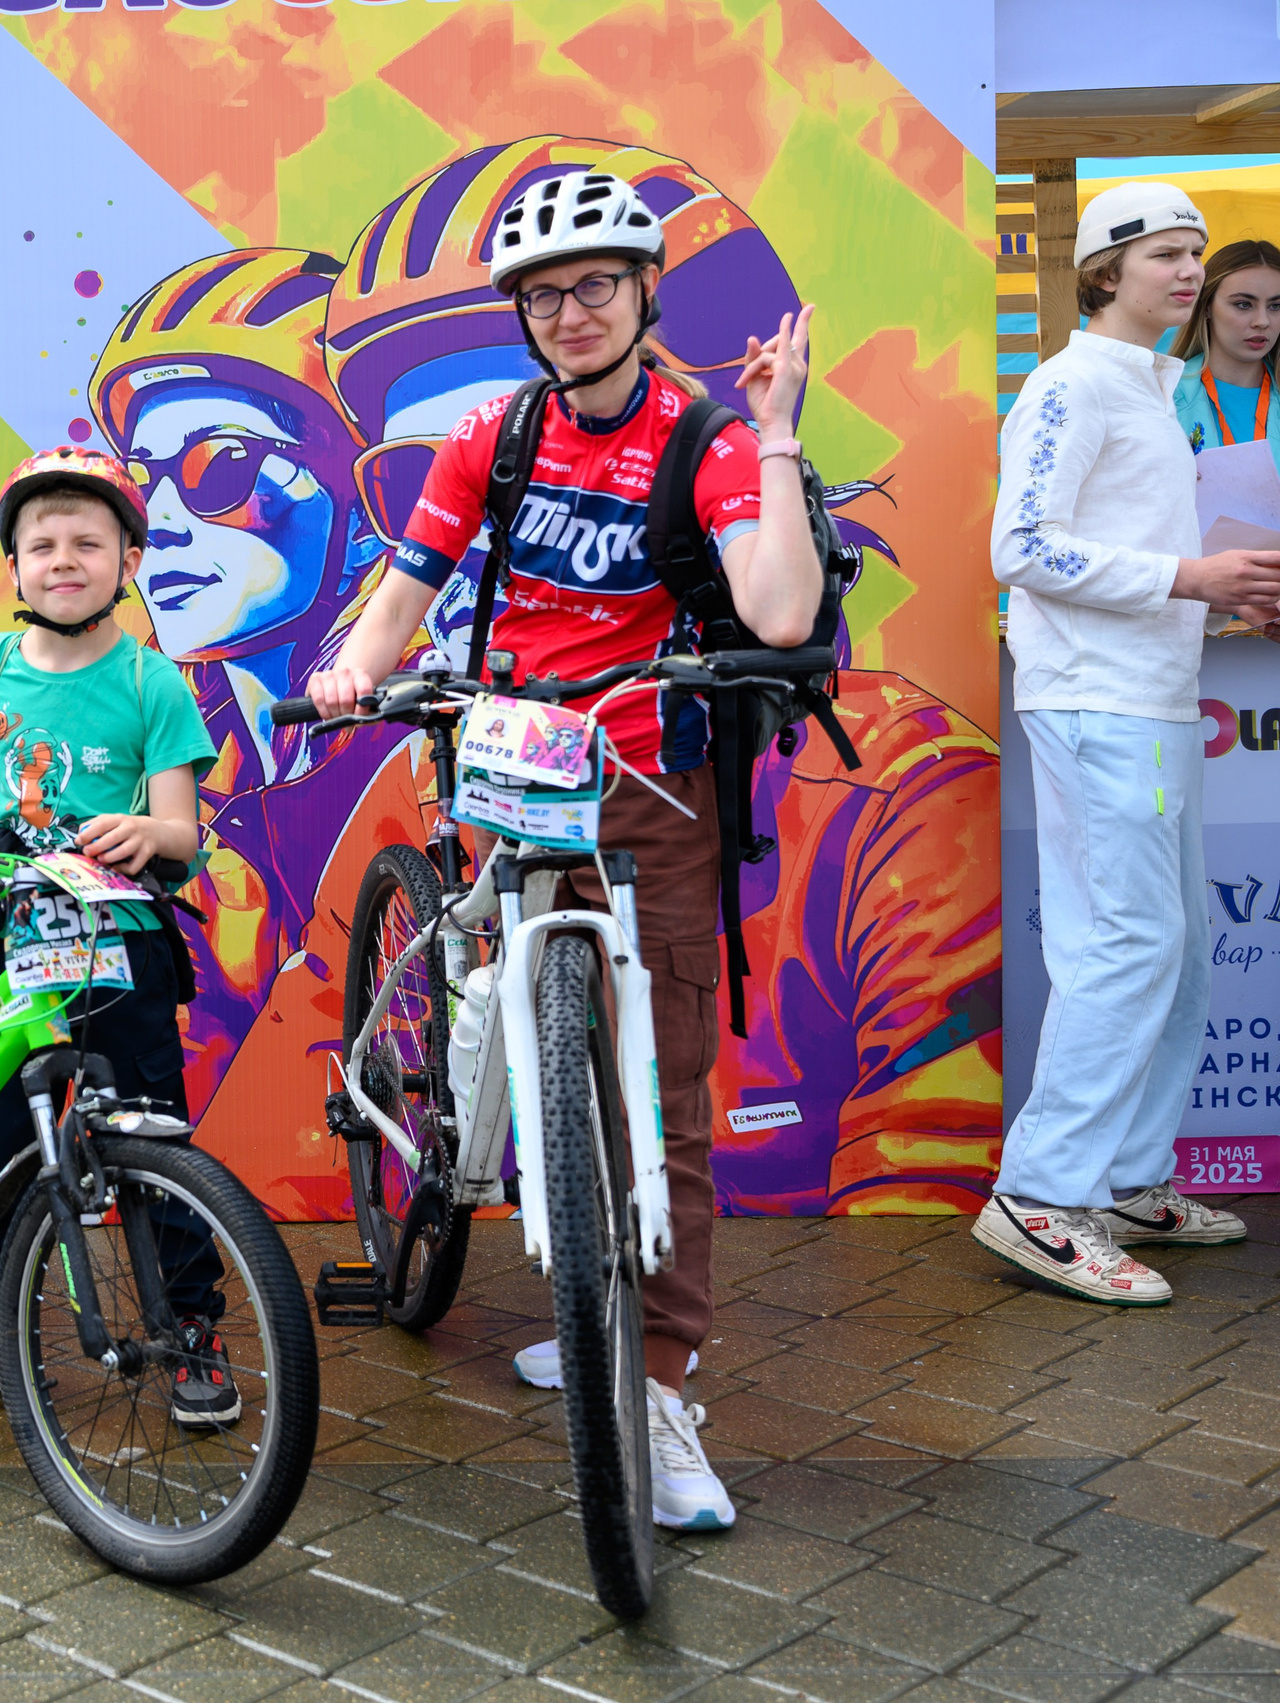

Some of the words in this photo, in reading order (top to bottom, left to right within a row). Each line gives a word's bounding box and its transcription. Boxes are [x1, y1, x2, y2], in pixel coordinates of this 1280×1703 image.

[396, 545, 428, 568] AAS
[465, 740, 514, 759] 00678
[1211, 932, 1263, 973] вар
[1199, 1052, 1280, 1075] АРН
[1190, 1147, 1209, 1162] 31
[1217, 1145, 1256, 1162] МАЯ
[1190, 1162, 1263, 1184] 2025
